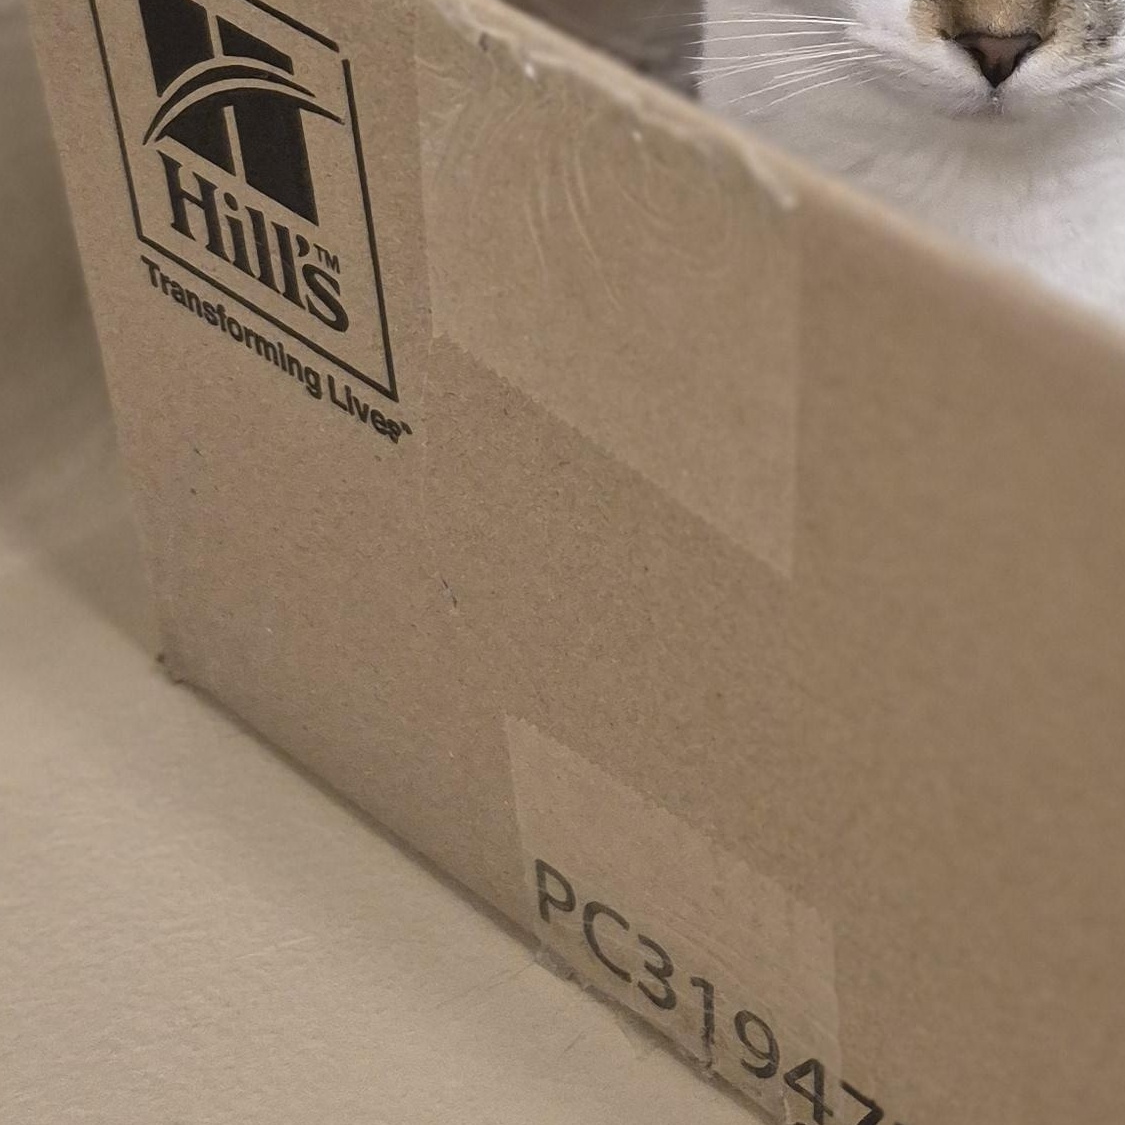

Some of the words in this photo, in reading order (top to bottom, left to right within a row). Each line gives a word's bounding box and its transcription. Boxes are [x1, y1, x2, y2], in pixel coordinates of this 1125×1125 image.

[140, 254, 323, 401] Transforming
[156, 149, 350, 333] Hill's
[535, 858, 904, 1125] PC31947
